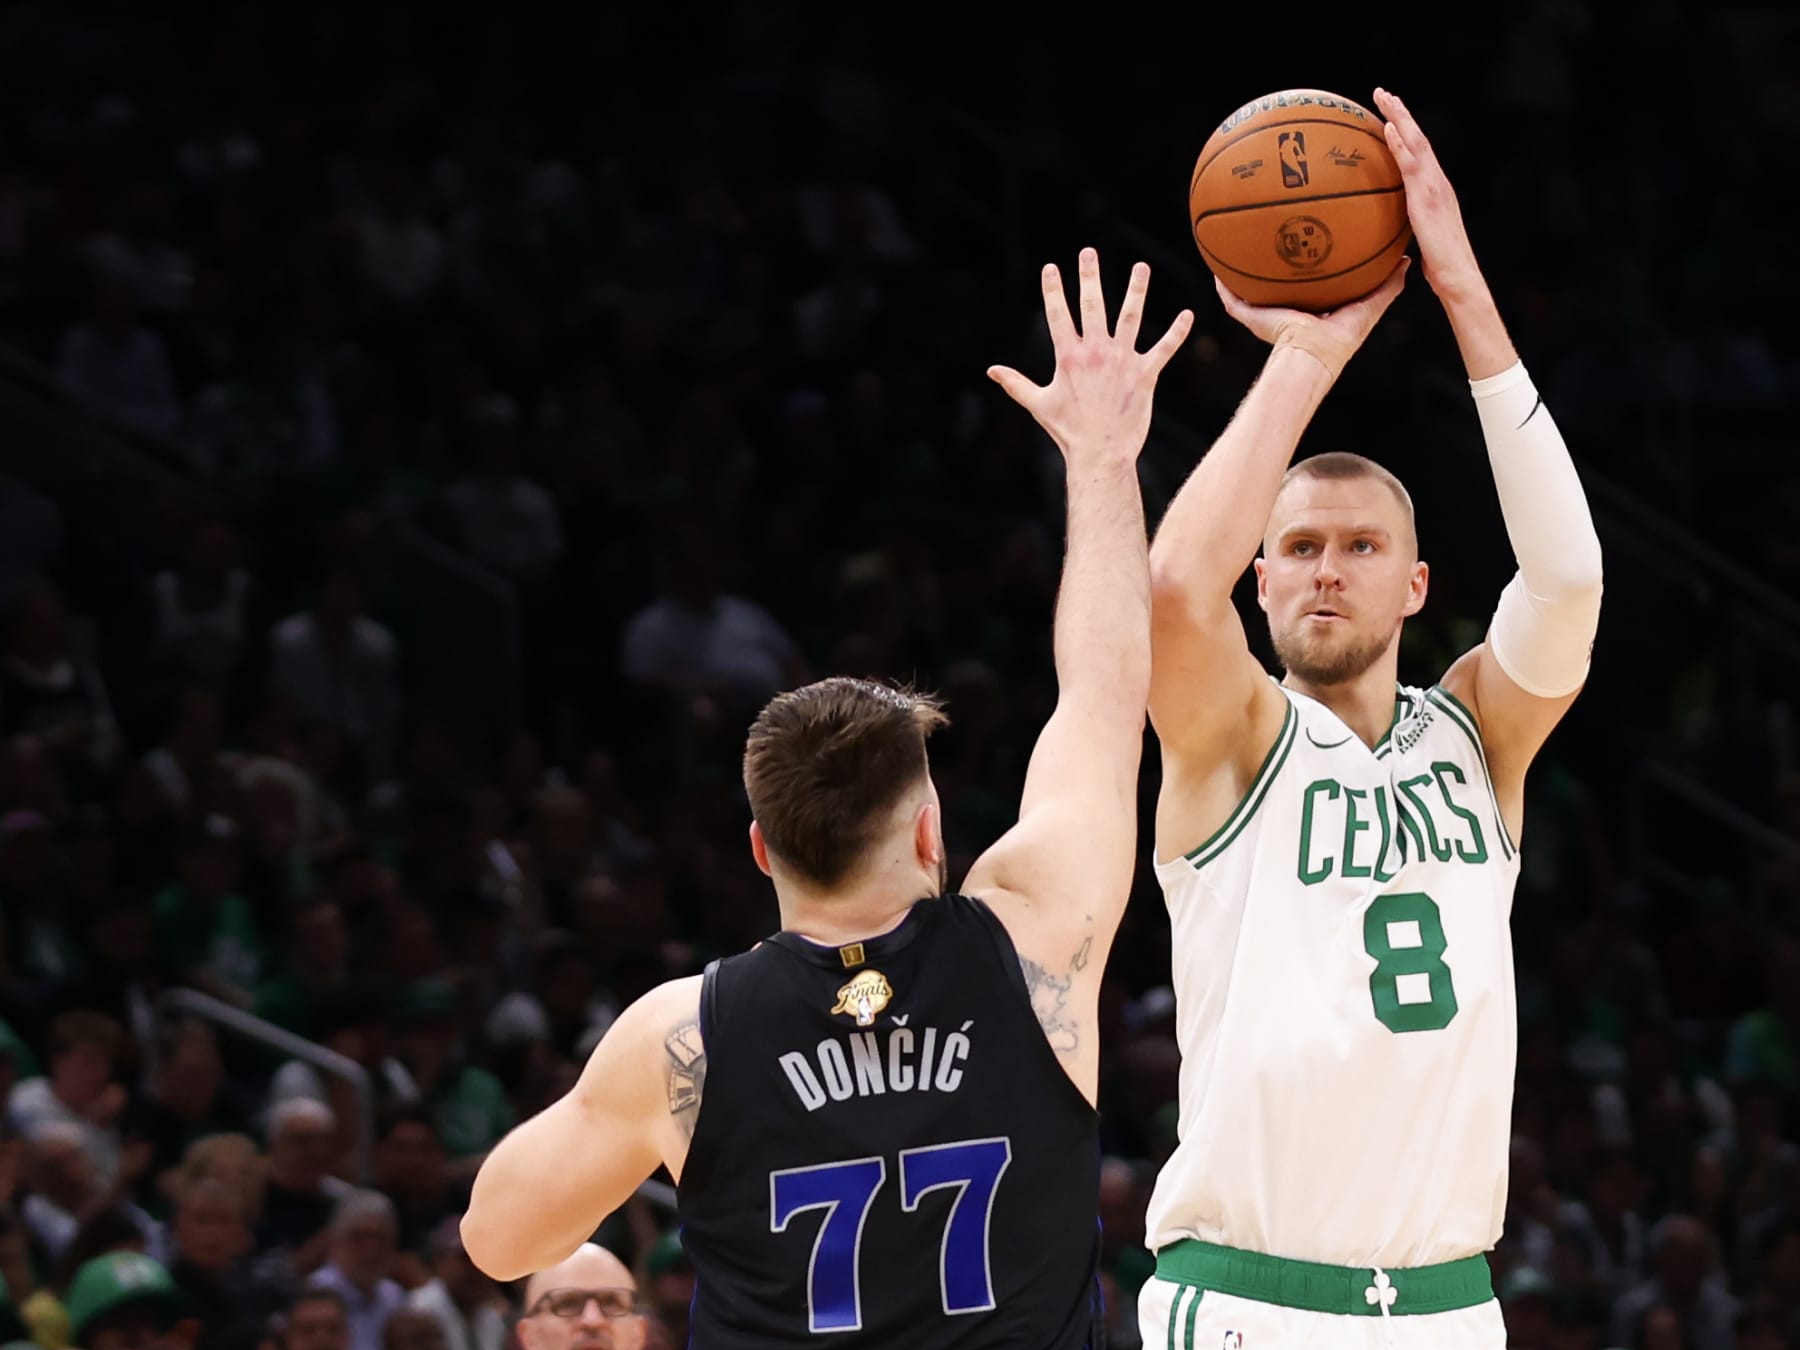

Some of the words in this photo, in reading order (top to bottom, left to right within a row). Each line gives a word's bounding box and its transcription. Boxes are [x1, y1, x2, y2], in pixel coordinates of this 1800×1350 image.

[1297, 761, 1489, 886] CELICS
[833, 976, 890, 1012] Finals
[1363, 891, 1459, 1034] 8
[778, 1013, 975, 1112] DONČIĆ
[769, 1136, 1013, 1334] 77
